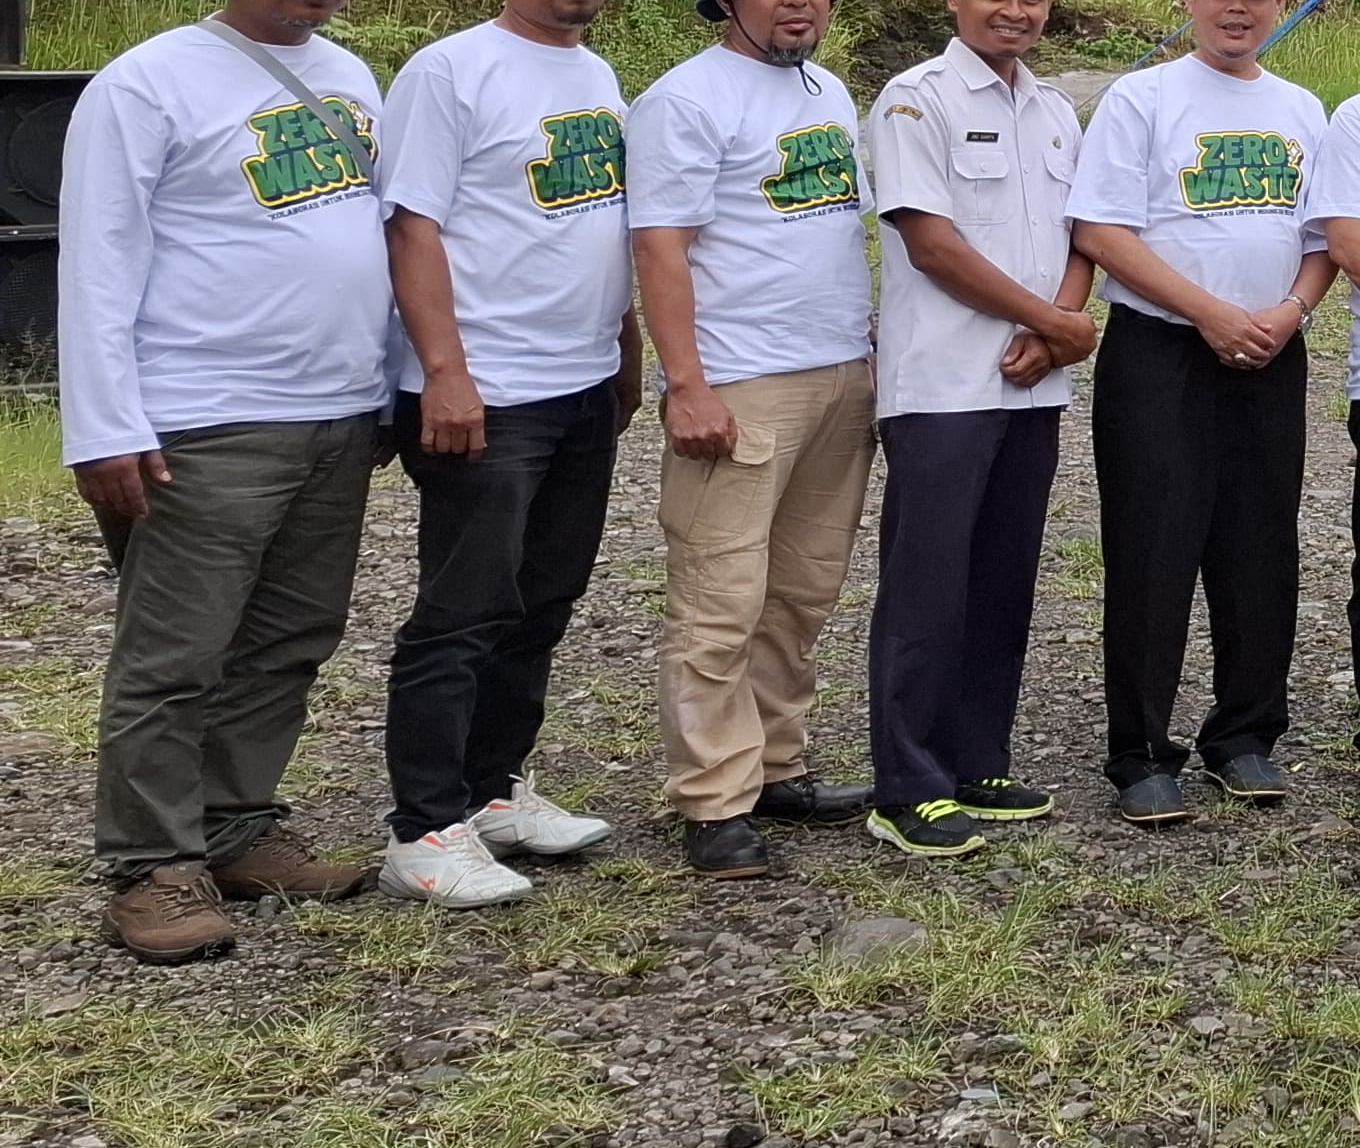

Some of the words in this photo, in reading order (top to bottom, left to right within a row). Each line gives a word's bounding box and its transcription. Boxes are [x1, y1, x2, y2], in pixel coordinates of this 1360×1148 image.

[543, 112, 621, 157] ZERO
[779, 126, 850, 172] ZERO
[1200, 135, 1288, 167] ZERO
[247, 139, 371, 199] WAST
[531, 147, 625, 199] WAST
[763, 158, 857, 205] WAST
[1184, 166, 1298, 203] WASTE
